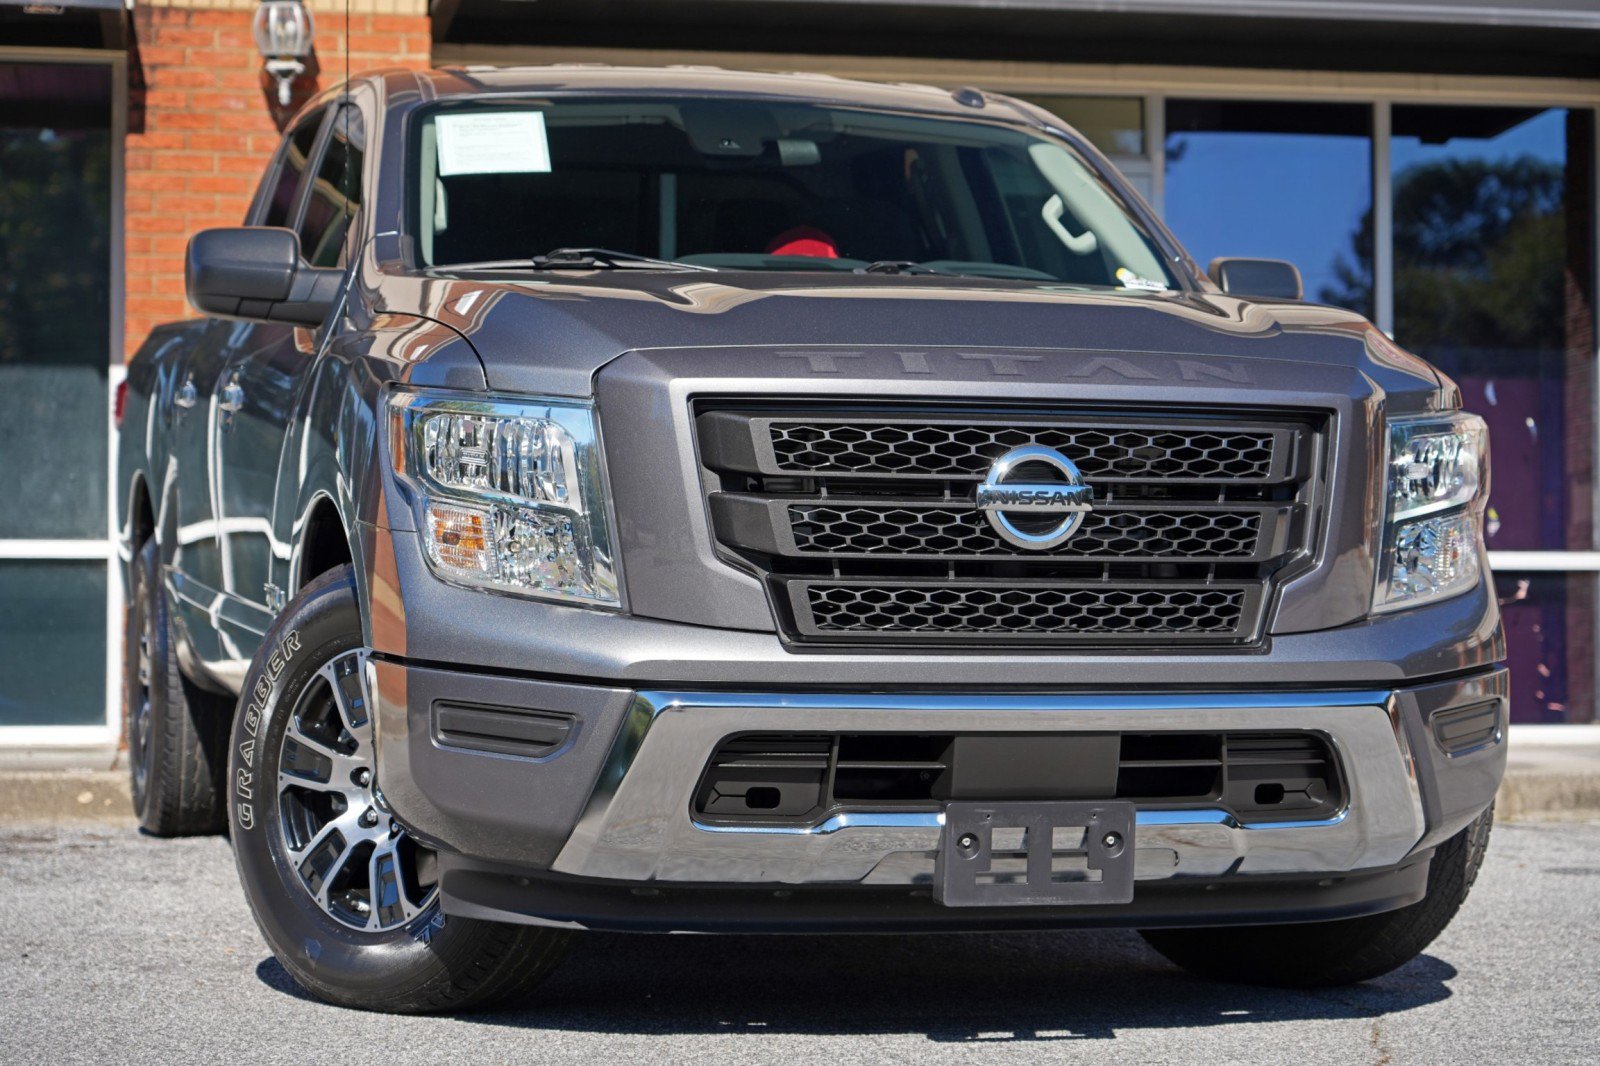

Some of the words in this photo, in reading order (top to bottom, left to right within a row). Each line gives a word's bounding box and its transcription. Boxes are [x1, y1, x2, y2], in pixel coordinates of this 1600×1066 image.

[774, 351, 1255, 384] TITAN
[990, 489, 1082, 507] NISSAN
[237, 629, 302, 830] GRABBER
